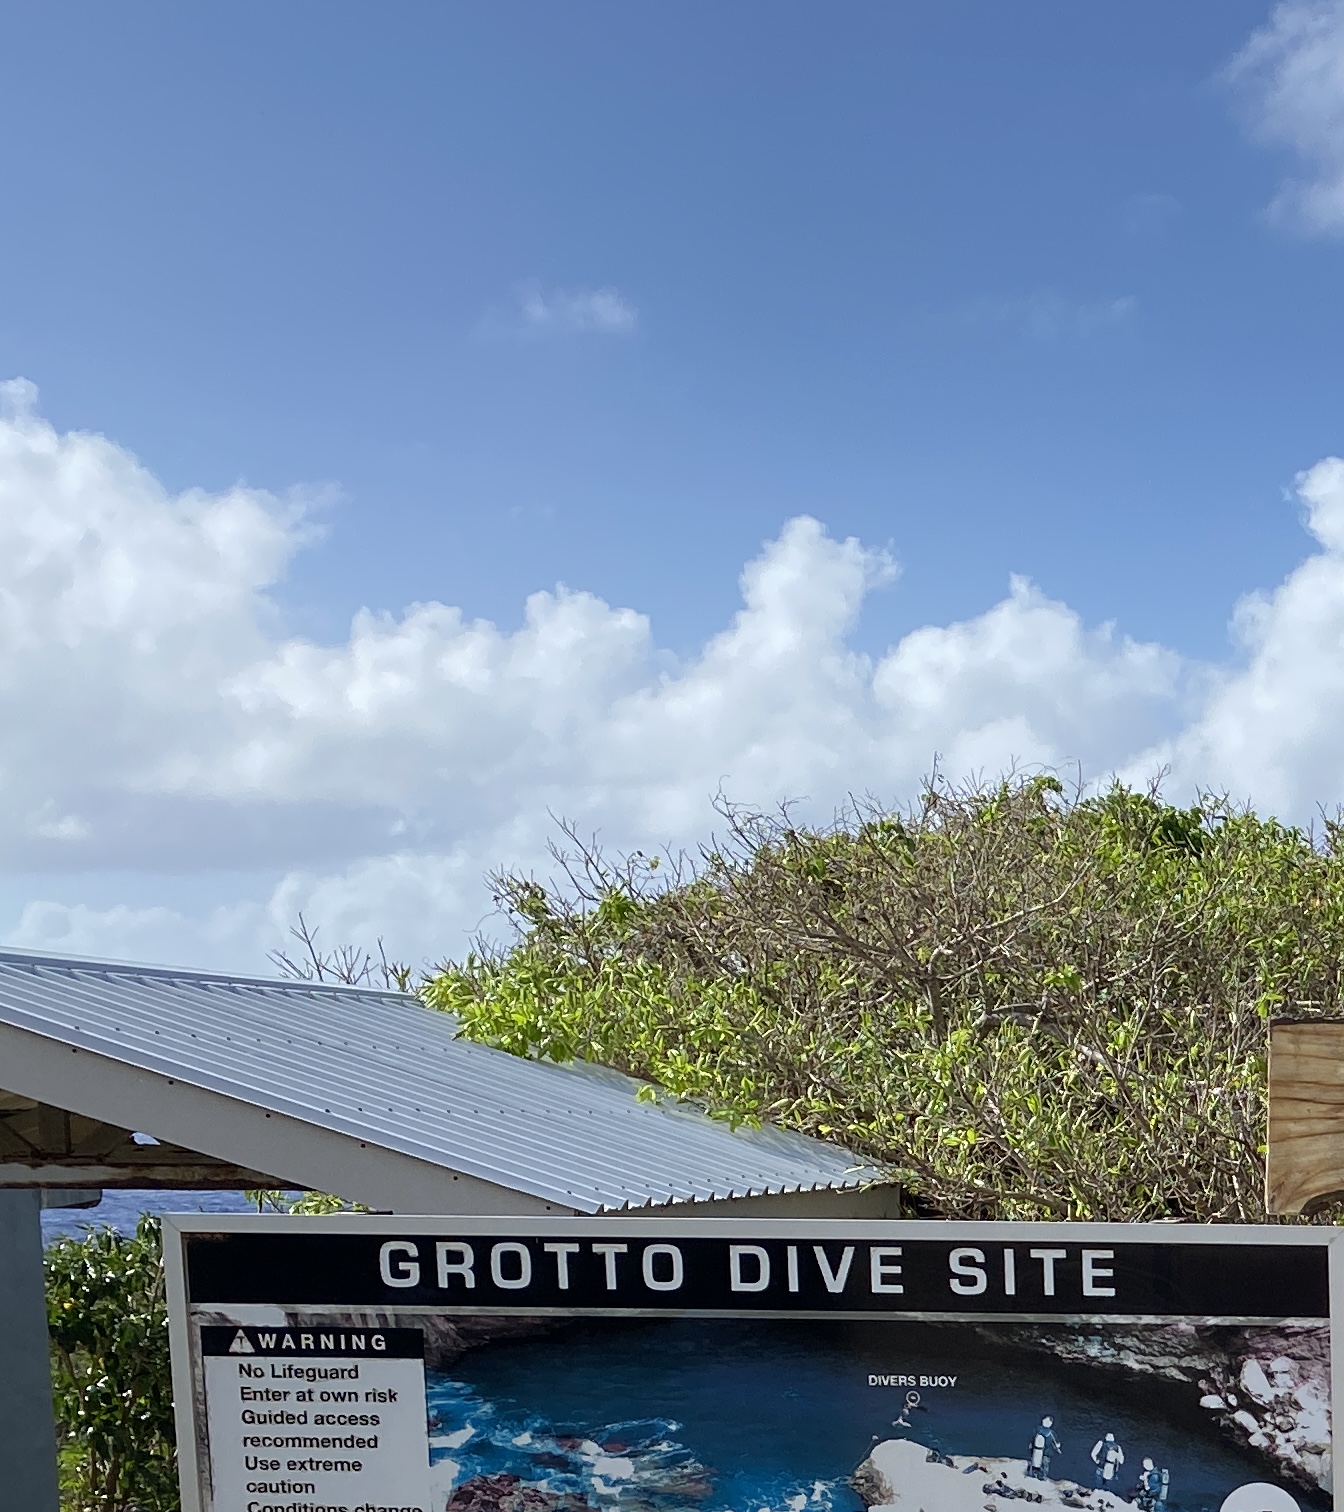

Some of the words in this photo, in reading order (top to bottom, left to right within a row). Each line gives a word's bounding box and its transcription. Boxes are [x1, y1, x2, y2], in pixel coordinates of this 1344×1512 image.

[379, 1241, 684, 1290] GROTTO
[730, 1245, 903, 1294] DIVE
[949, 1247, 1116, 1297] SITE
[258, 1333, 387, 1350] WARNING
[239, 1363, 265, 1379] No
[271, 1364, 360, 1382] Lifeguard
[868, 1375, 916, 1387] DIVERS
[919, 1376, 957, 1387] BUOY
[240, 1387, 291, 1402] Enter
[296, 1388, 314, 1402] at
[320, 1391, 359, 1402] own
[365, 1388, 398, 1403] risk
[241, 1410, 308, 1425] Guided
[314, 1413, 380, 1426] access
[243, 1434, 379, 1449] recommended
[245, 1456, 280, 1471] Use
[287, 1457, 363, 1472] extreme
[246, 1479, 315, 1494] caution
